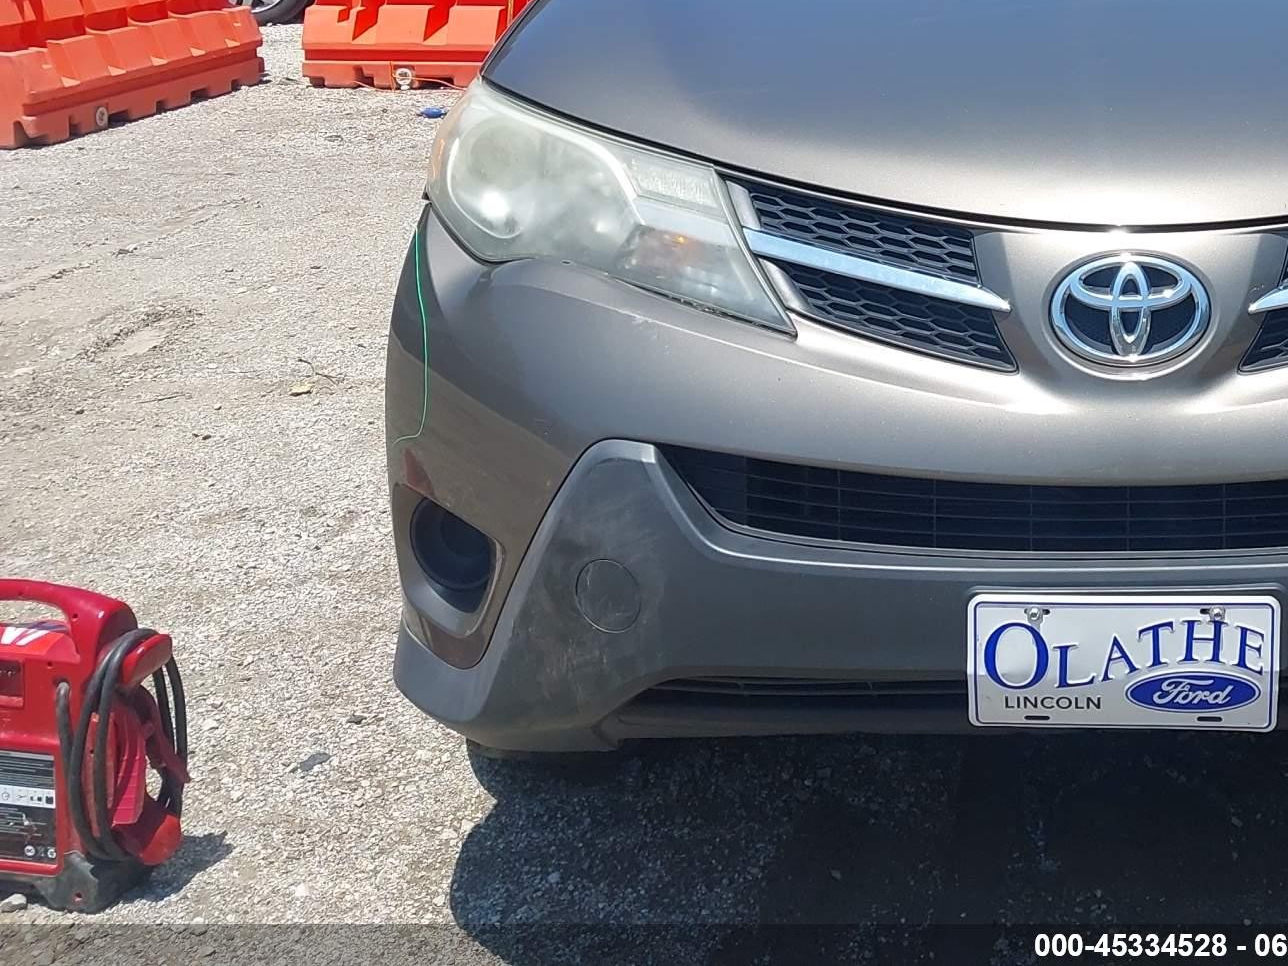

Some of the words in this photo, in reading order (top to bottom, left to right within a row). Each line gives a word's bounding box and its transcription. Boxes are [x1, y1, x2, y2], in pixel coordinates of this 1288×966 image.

[983, 619, 1265, 691] OLATHE
[1004, 696, 1102, 710] LINCOLN
[1153, 677, 1232, 706] Ford
